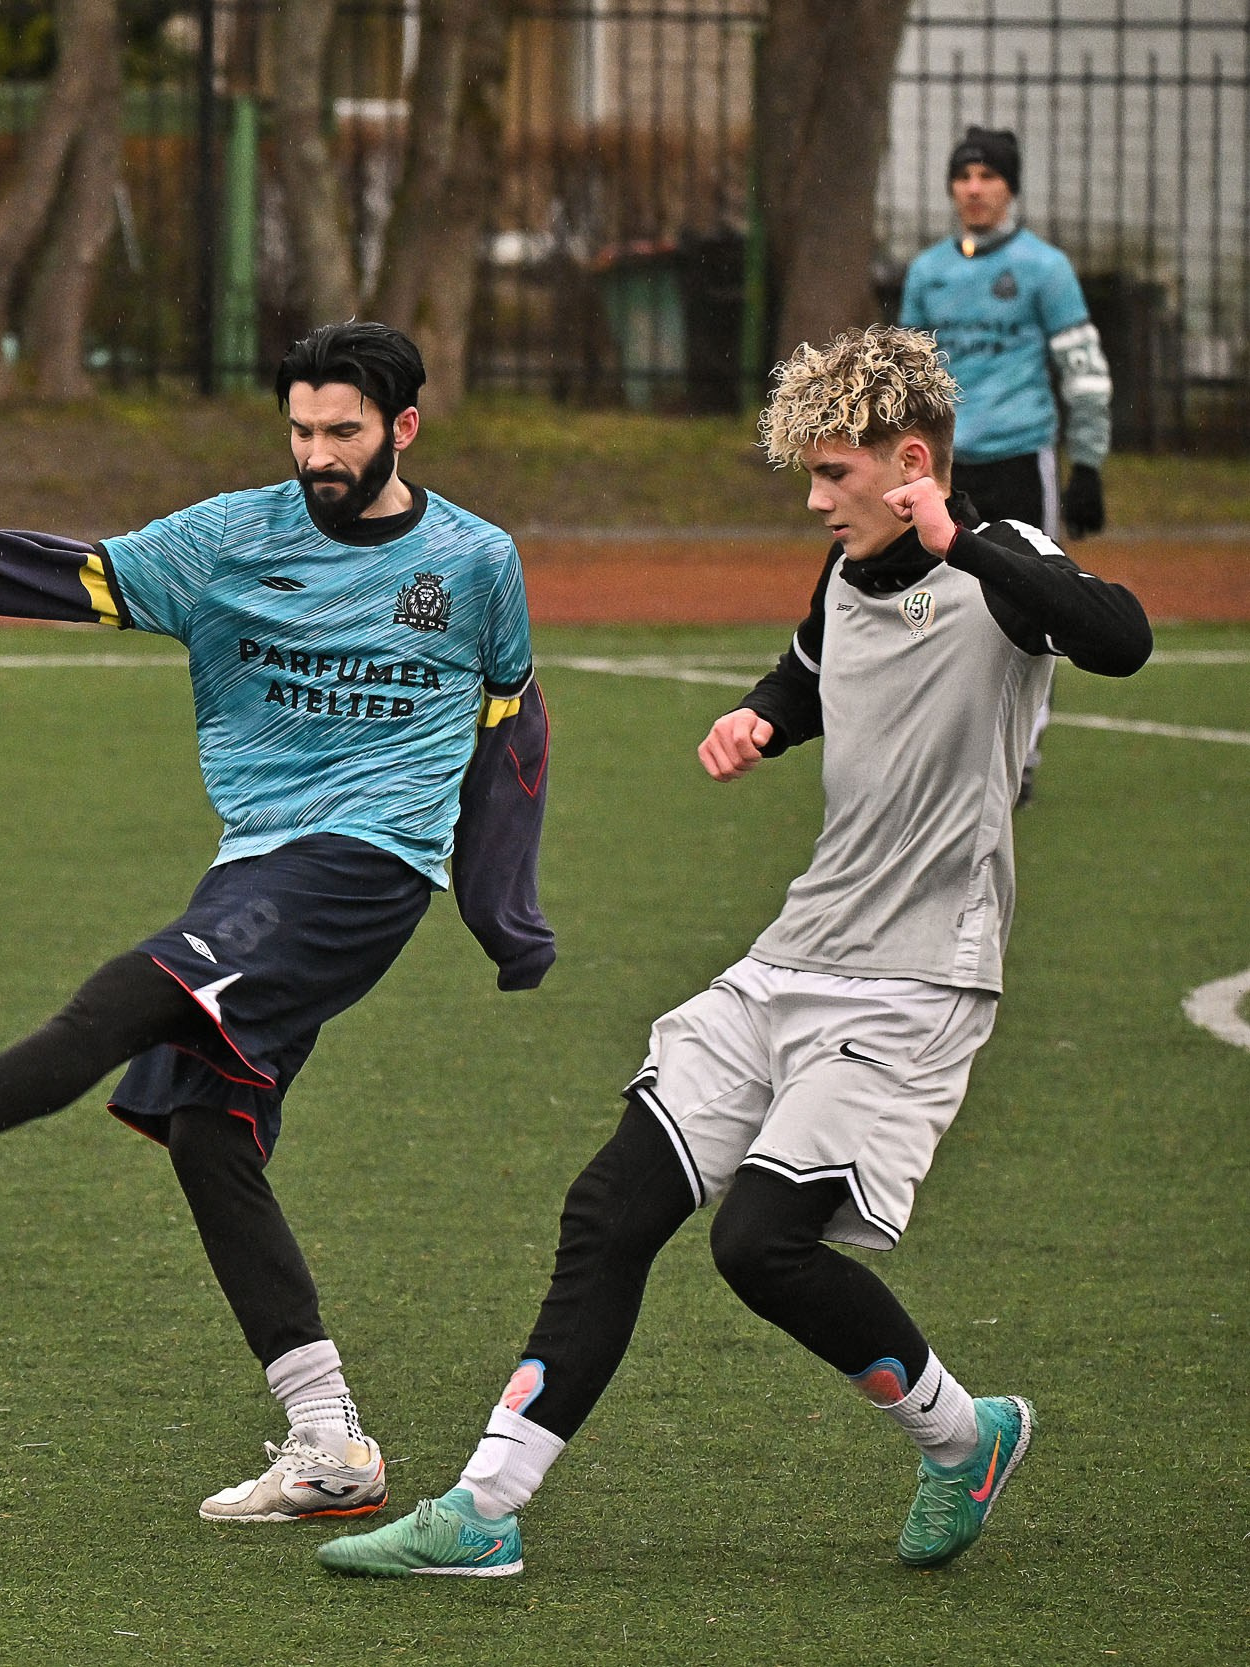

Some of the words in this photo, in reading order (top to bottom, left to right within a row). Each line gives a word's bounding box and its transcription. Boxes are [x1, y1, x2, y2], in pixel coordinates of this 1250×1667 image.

[398, 616, 445, 630] PRIDE
[238, 638, 442, 691] PARFUMER
[264, 680, 415, 719] ATELIER
